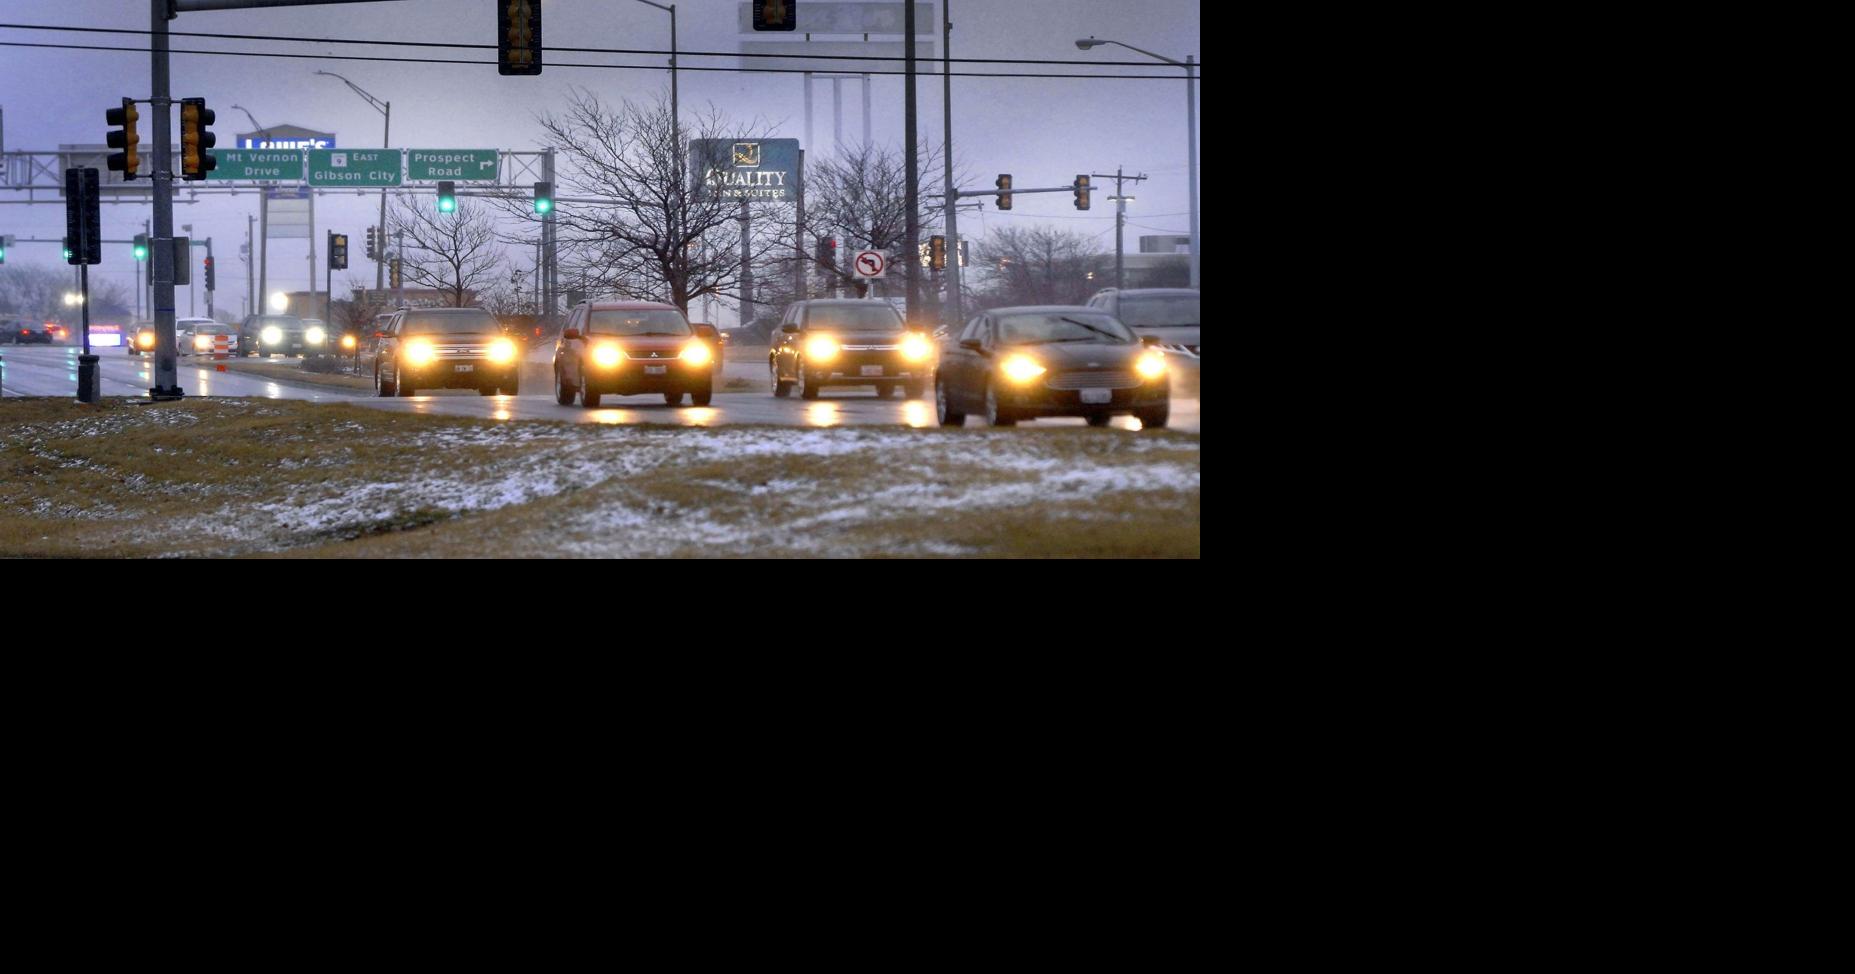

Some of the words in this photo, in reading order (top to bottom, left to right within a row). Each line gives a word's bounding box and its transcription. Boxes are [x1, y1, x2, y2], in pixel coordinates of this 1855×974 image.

[226, 153, 242, 162] Mt
[250, 153, 298, 162] Vernon
[353, 152, 378, 161] EAST
[415, 153, 474, 164] Prospect
[245, 166, 280, 176] Drive
[314, 171, 361, 181] Gibson
[369, 171, 395, 182] City
[428, 166, 462, 177] Road
[705, 168, 787, 187] QUALITY
